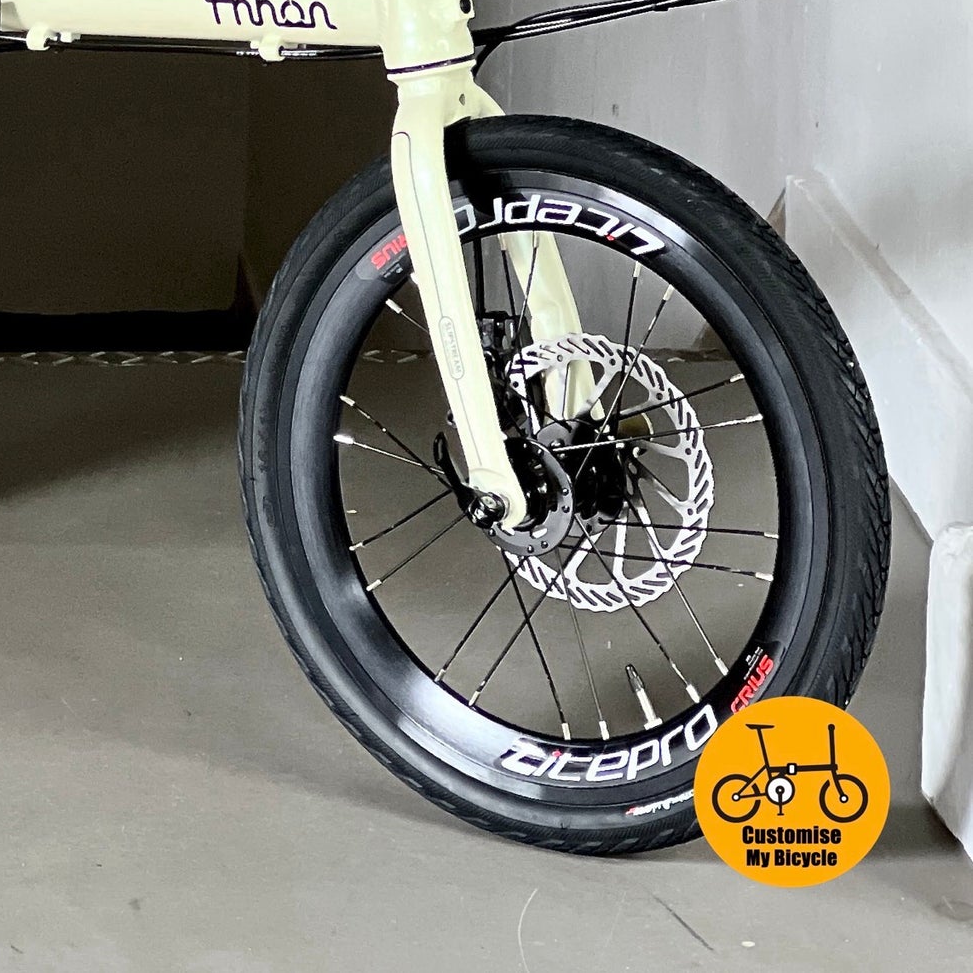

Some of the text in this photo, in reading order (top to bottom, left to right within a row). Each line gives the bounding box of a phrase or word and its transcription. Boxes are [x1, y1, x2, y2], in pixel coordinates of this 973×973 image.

[370, 233, 408, 270] RIUS
[444, 321, 462, 373] SLIPSTREAM
[730, 654, 774, 715] CRIUS
